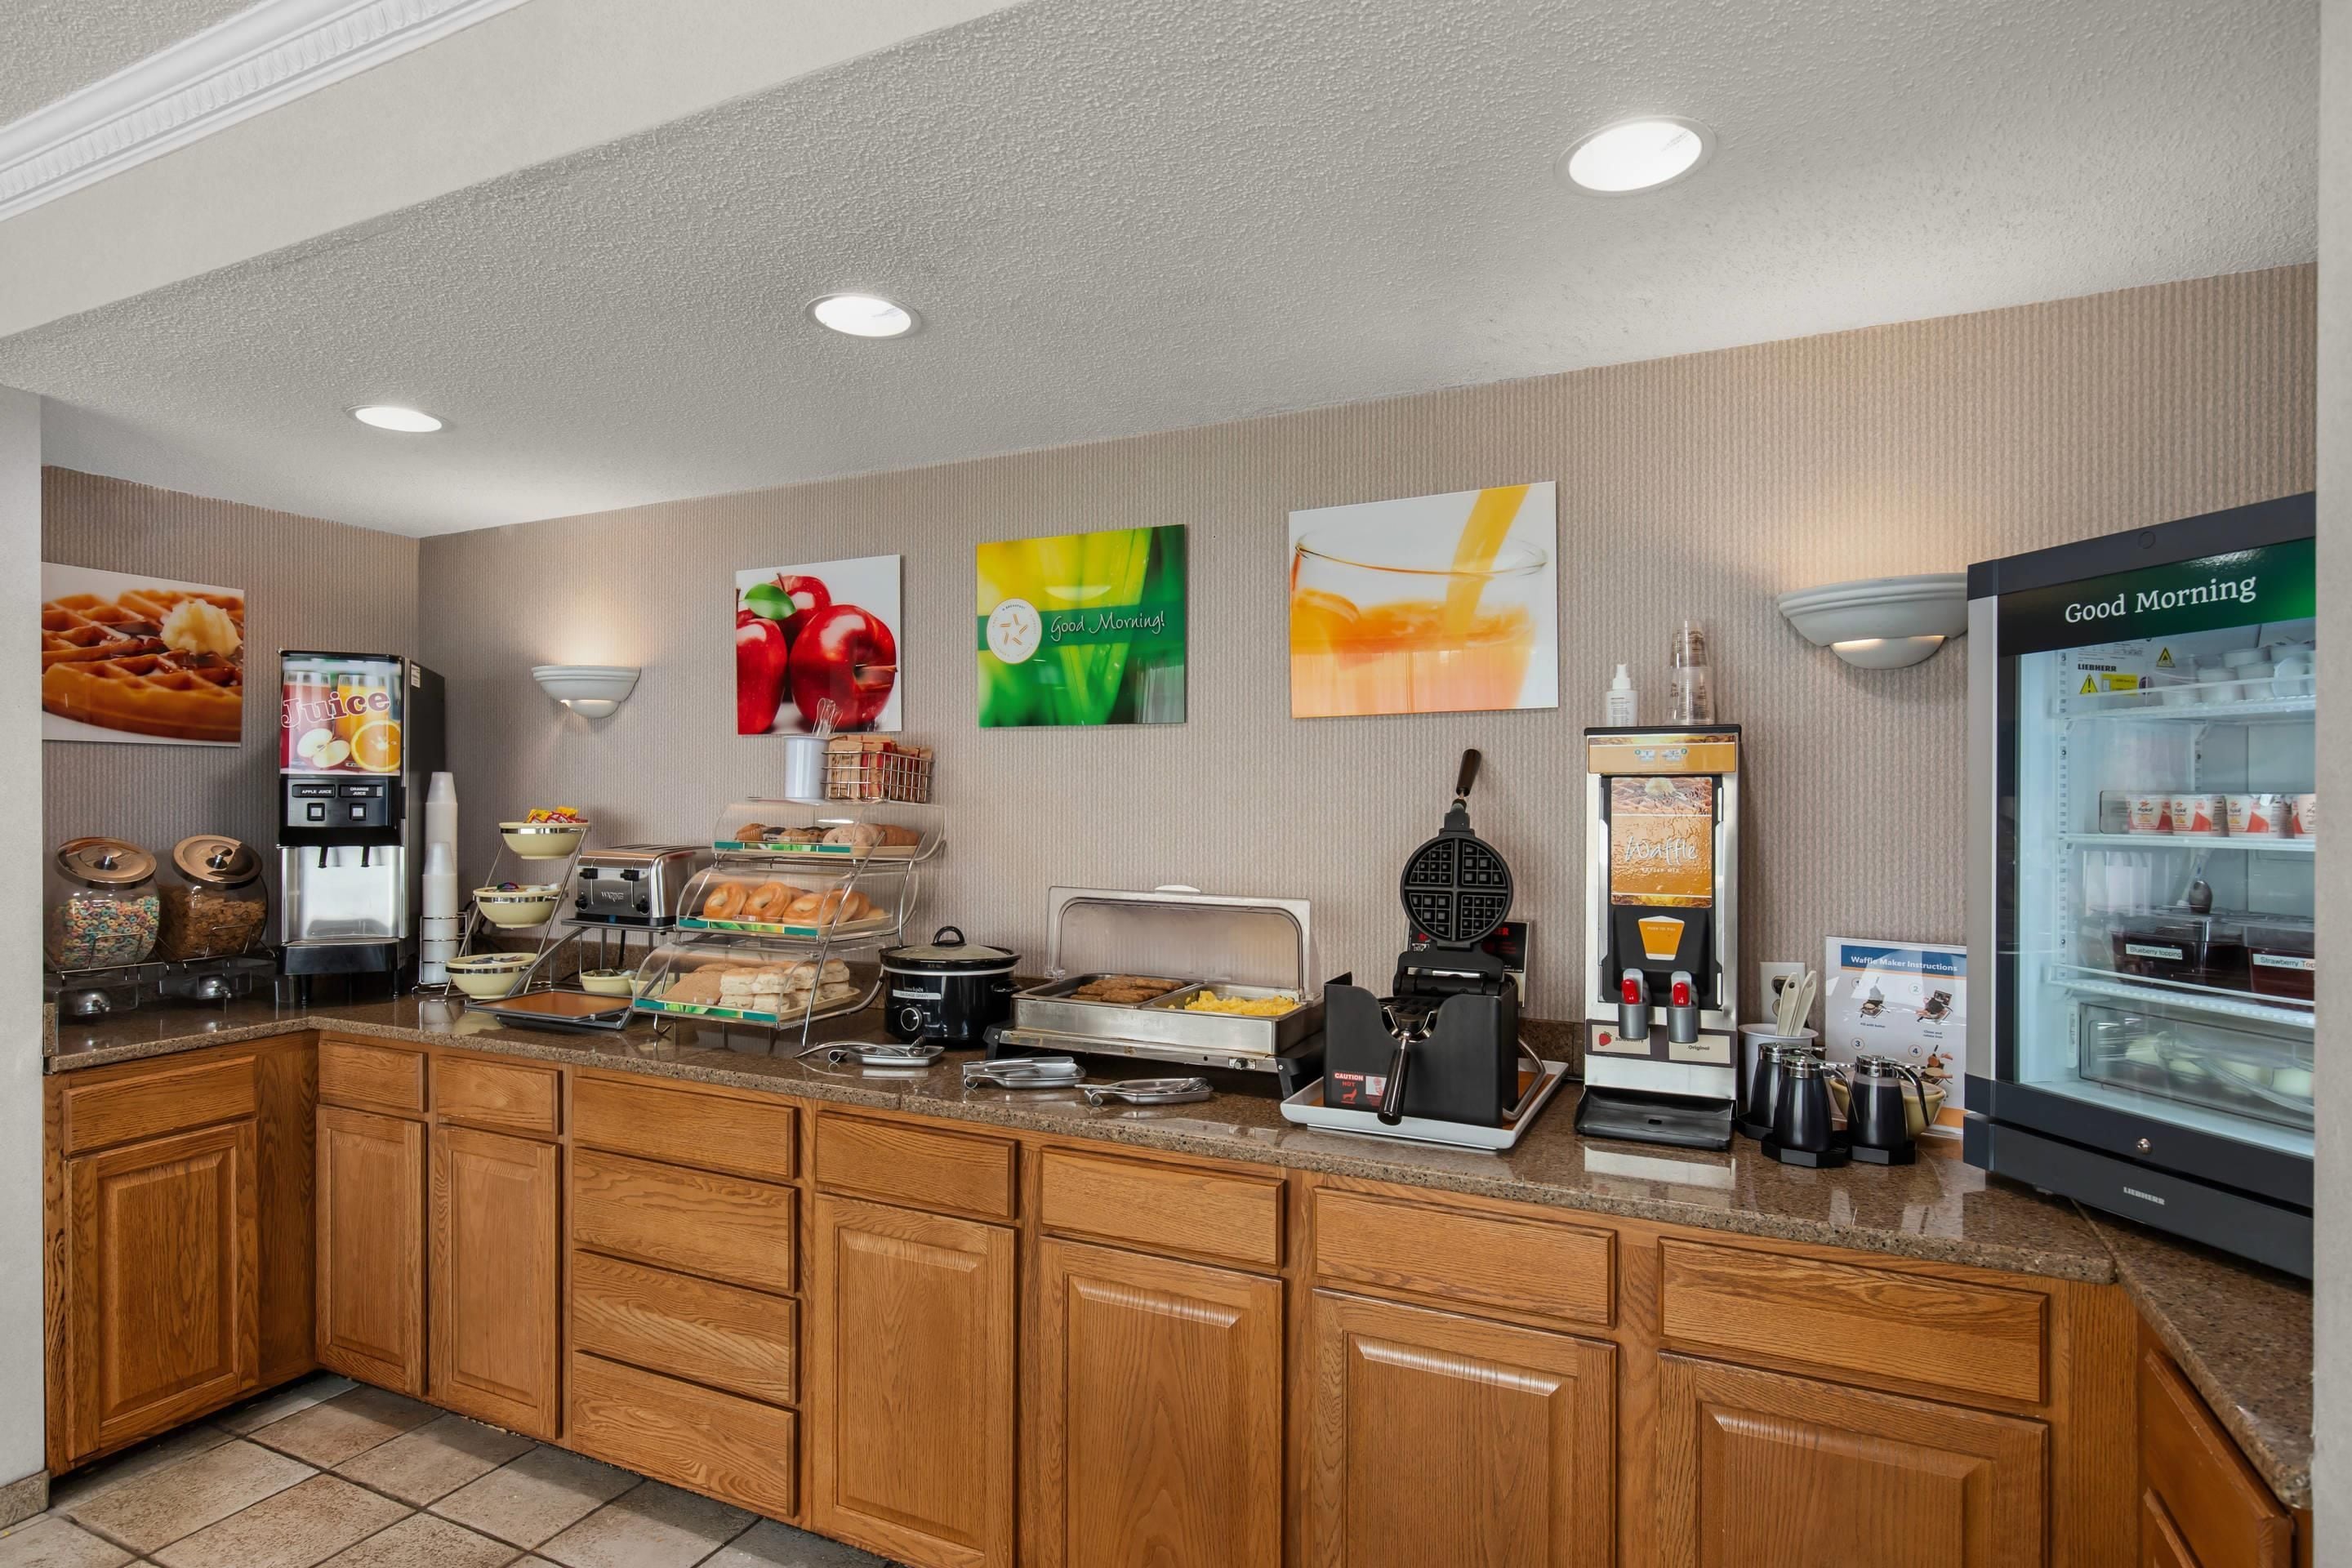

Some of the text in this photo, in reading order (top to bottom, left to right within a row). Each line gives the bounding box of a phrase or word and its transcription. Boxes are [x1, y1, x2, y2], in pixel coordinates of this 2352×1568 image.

[2065, 576, 2256, 623] Good Morning
[1051, 615, 1085, 642] Good
[1089, 610, 1165, 635] Morning!
[2078, 663, 2117, 672] LIEBHERR
[280, 692, 390, 728] Juice
[1624, 835, 1699, 866] Waffle
[2130, 947, 2182, 958] Blueberry topping
[1851, 956, 1958, 972] Waffle Maker Instructions
[2261, 956, 2299, 968] Strawberry
[1334, 1072, 1364, 1081] CAUTION
